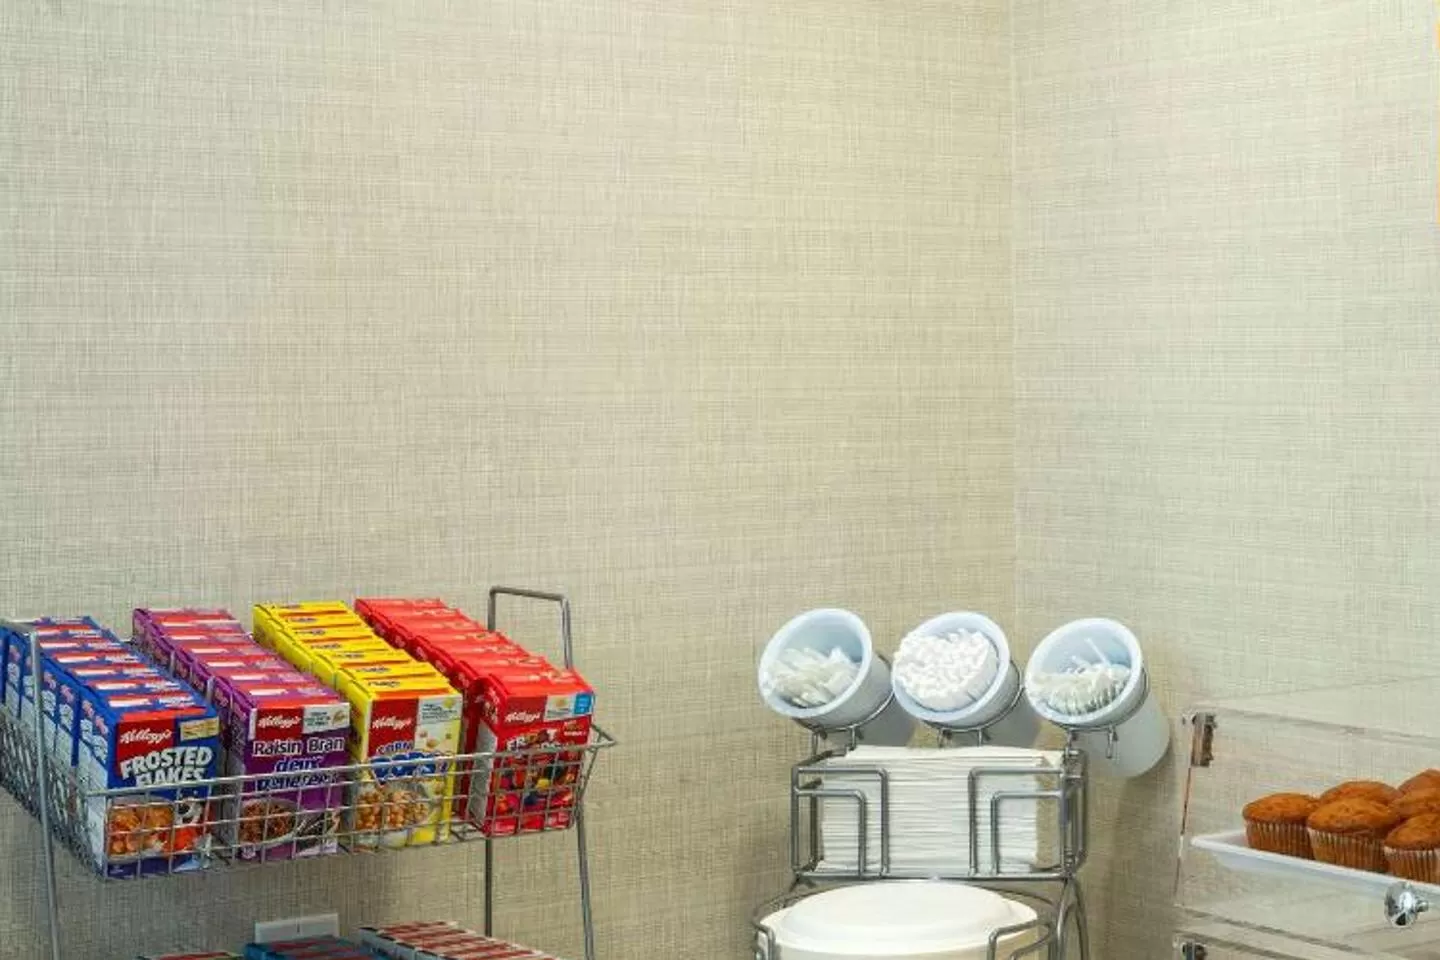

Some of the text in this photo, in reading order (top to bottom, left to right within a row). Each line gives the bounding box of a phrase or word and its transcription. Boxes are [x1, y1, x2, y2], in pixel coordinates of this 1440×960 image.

[120, 728, 172, 744] Kellogg's
[253, 736, 345, 757] Raisin Bran
[120, 746, 213, 780] FROSTED
